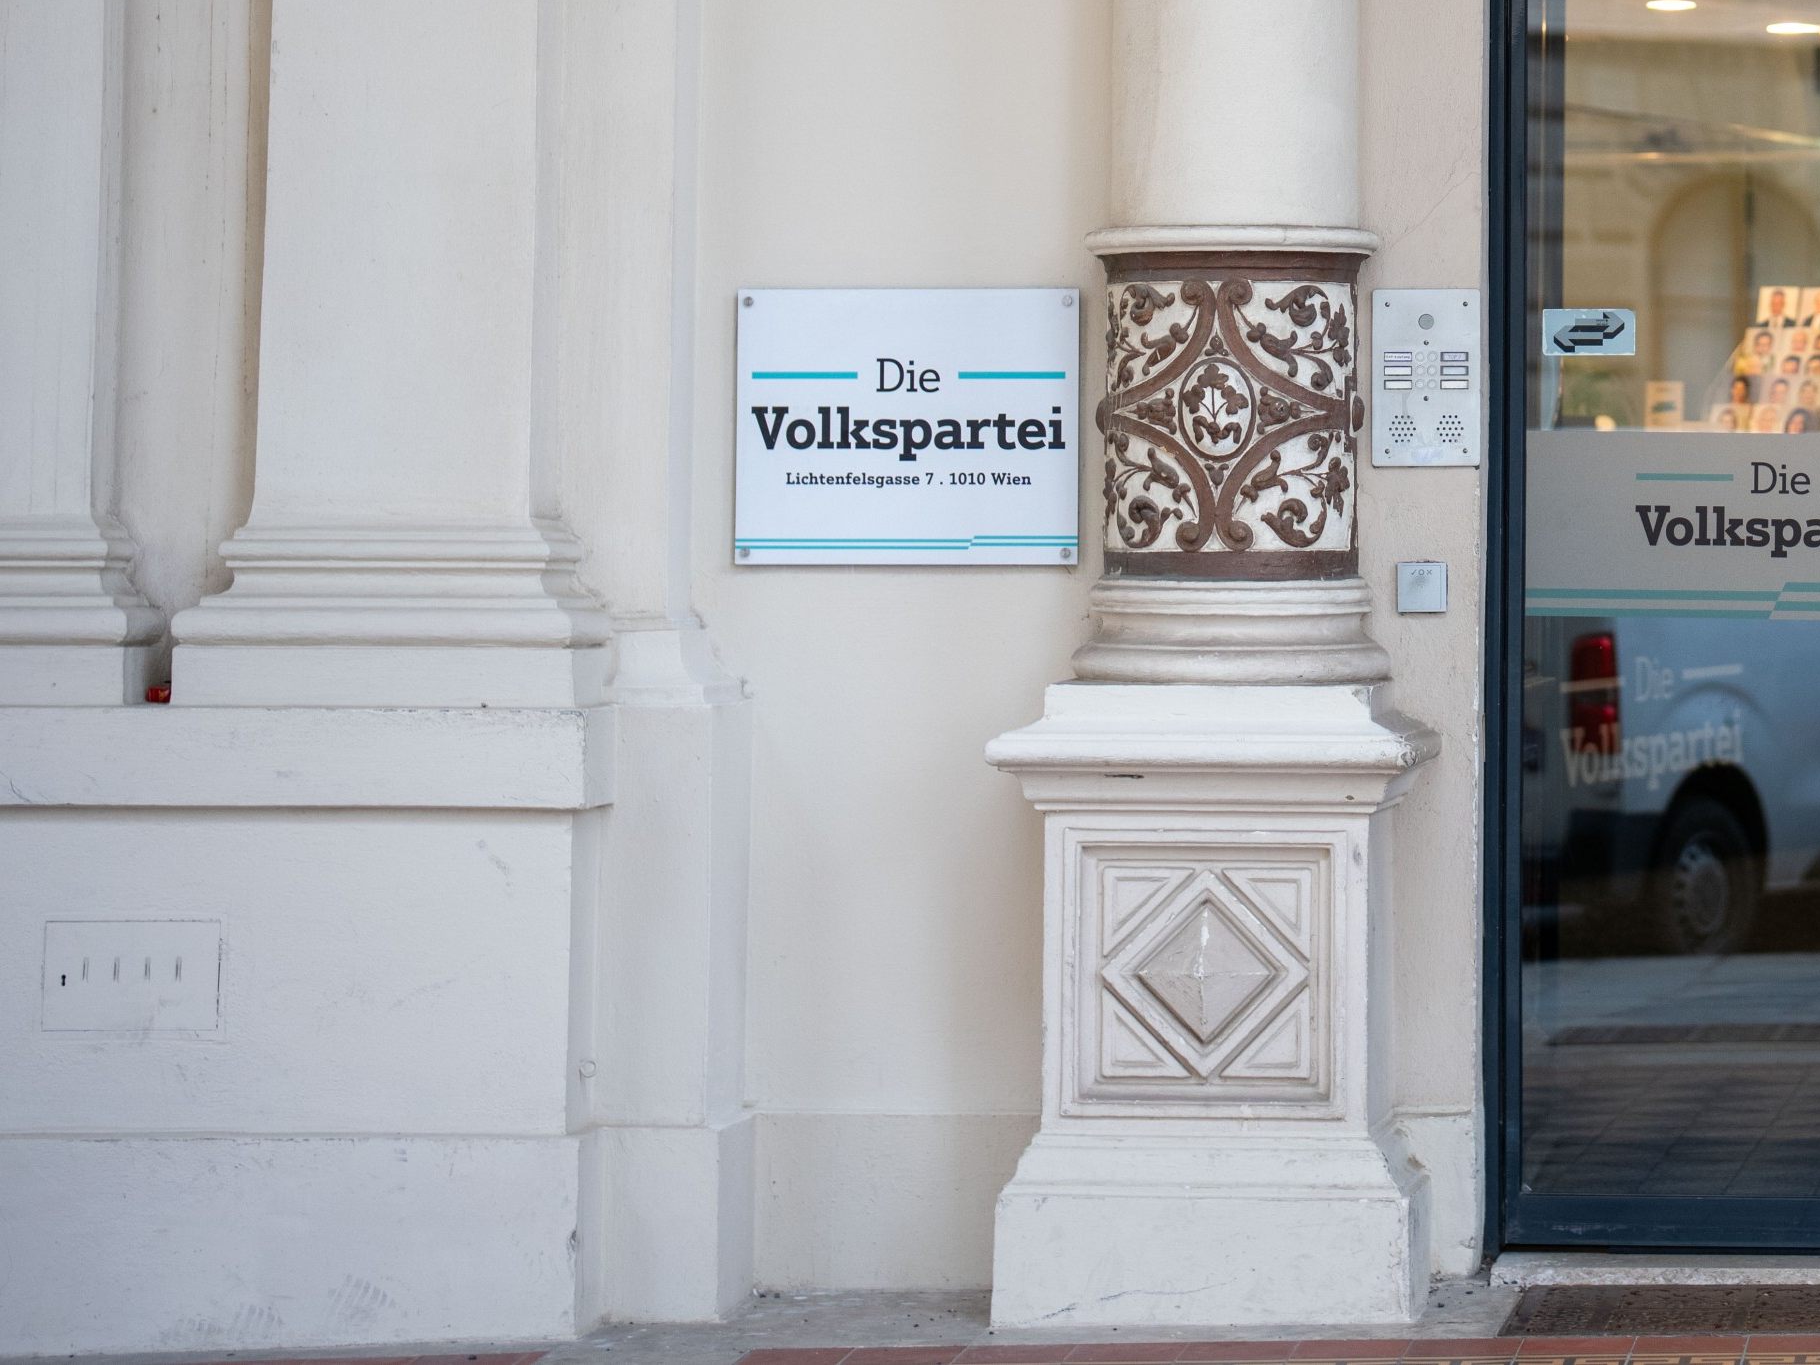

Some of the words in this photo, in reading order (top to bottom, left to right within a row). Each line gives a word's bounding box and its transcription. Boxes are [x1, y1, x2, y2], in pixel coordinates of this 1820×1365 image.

[876, 358, 941, 393] Die
[751, 406, 1066, 462] Volkspartei
[785, 472, 921, 489] Lichtenfelsgasse
[925, 472, 934, 486] 7
[949, 472, 986, 486] 1010
[991, 472, 1032, 486] Wien
[1750, 461, 1811, 495] Die
[1634, 655, 1675, 702] Die
[1559, 708, 1744, 791] Volkspartei
